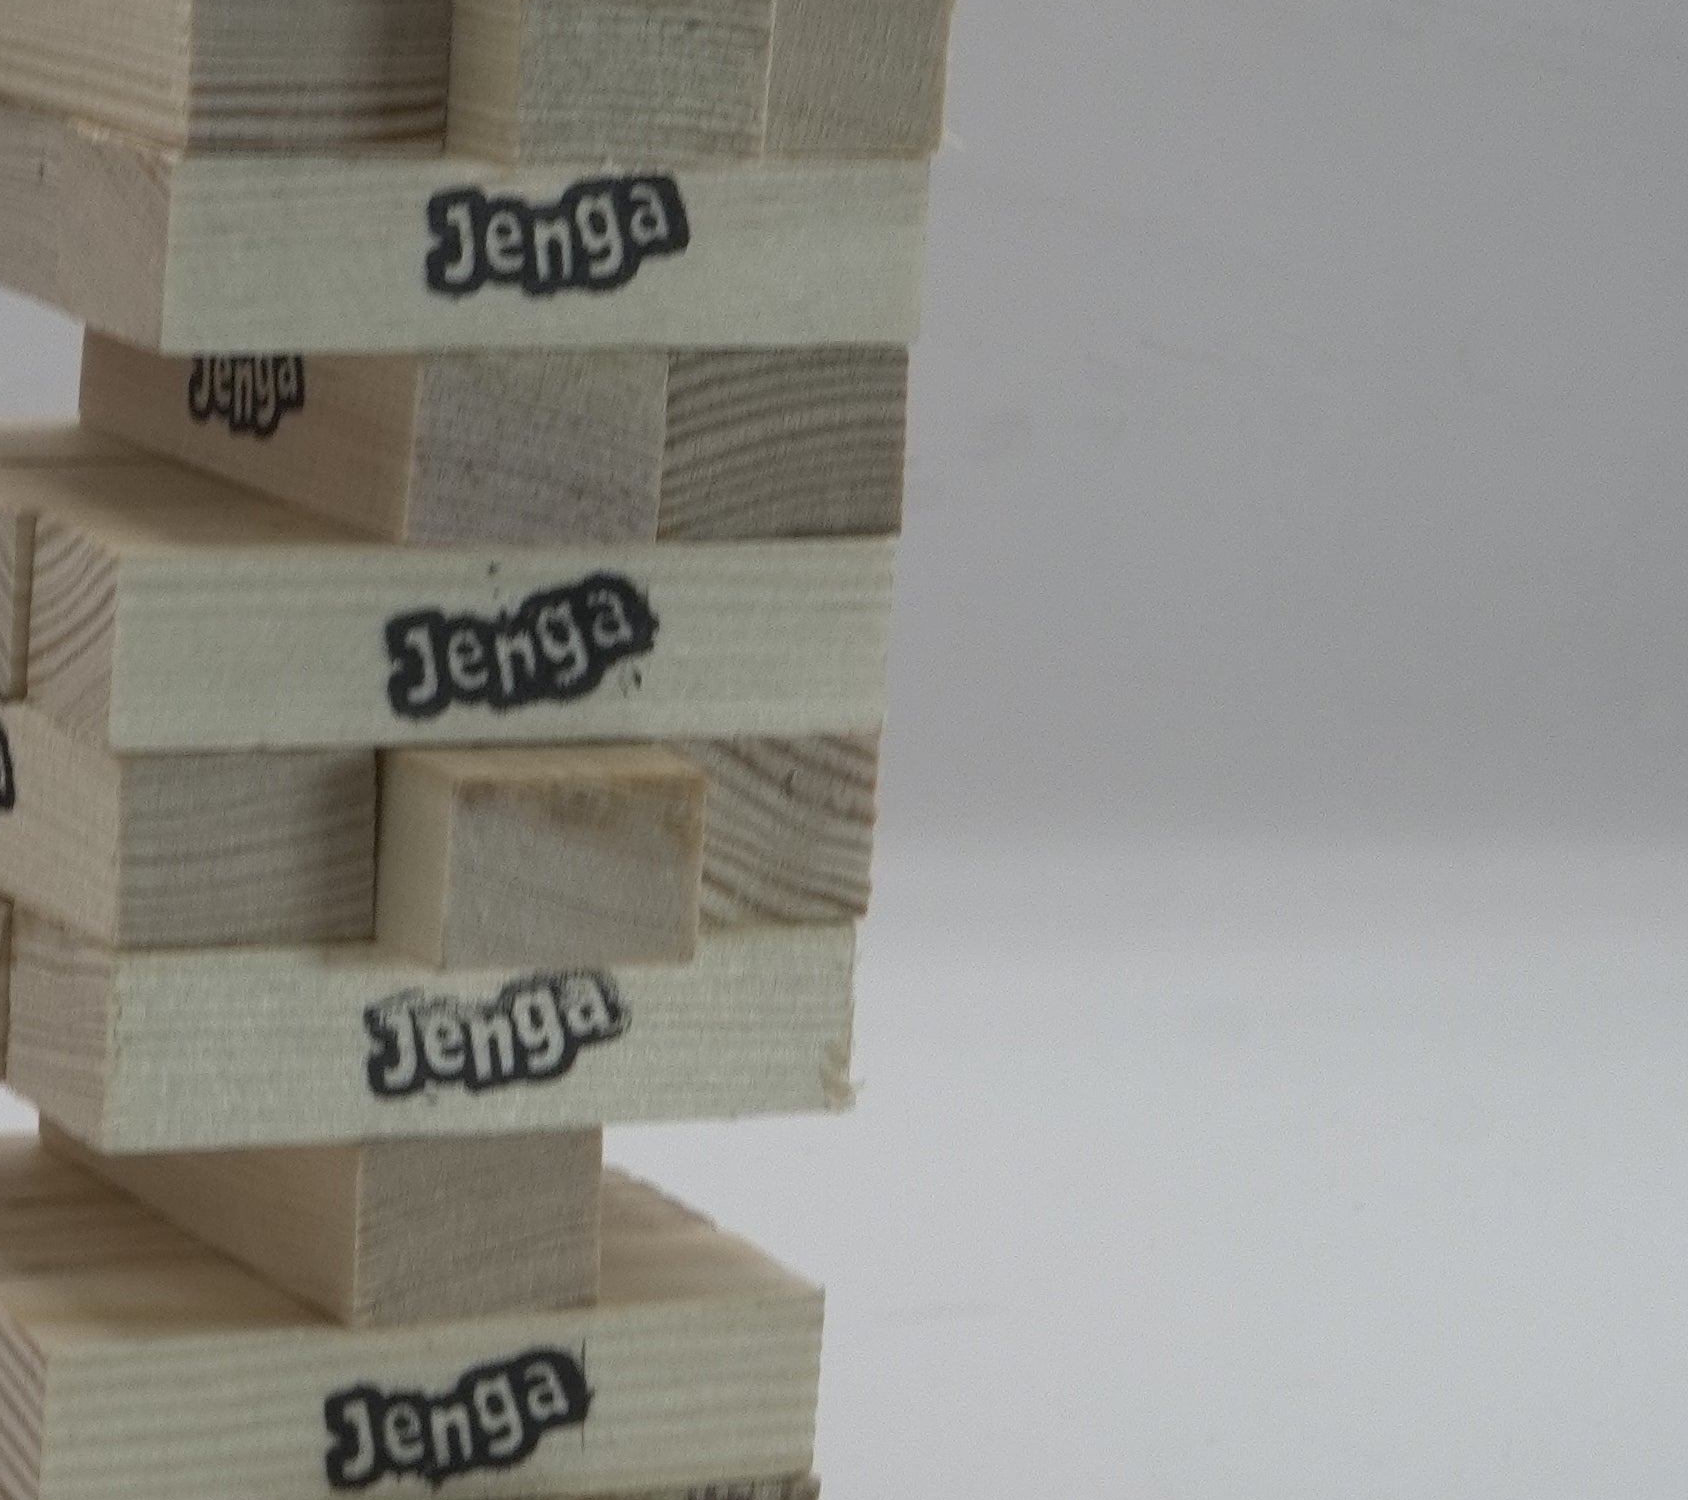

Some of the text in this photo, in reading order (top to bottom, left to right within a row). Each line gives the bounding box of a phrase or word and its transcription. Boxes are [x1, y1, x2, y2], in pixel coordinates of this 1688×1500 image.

[431, 178, 681, 289] Jenga
[393, 579, 644, 712] Jenga
[370, 974, 622, 1091] Jenga
[331, 1353, 579, 1482] Jenga
